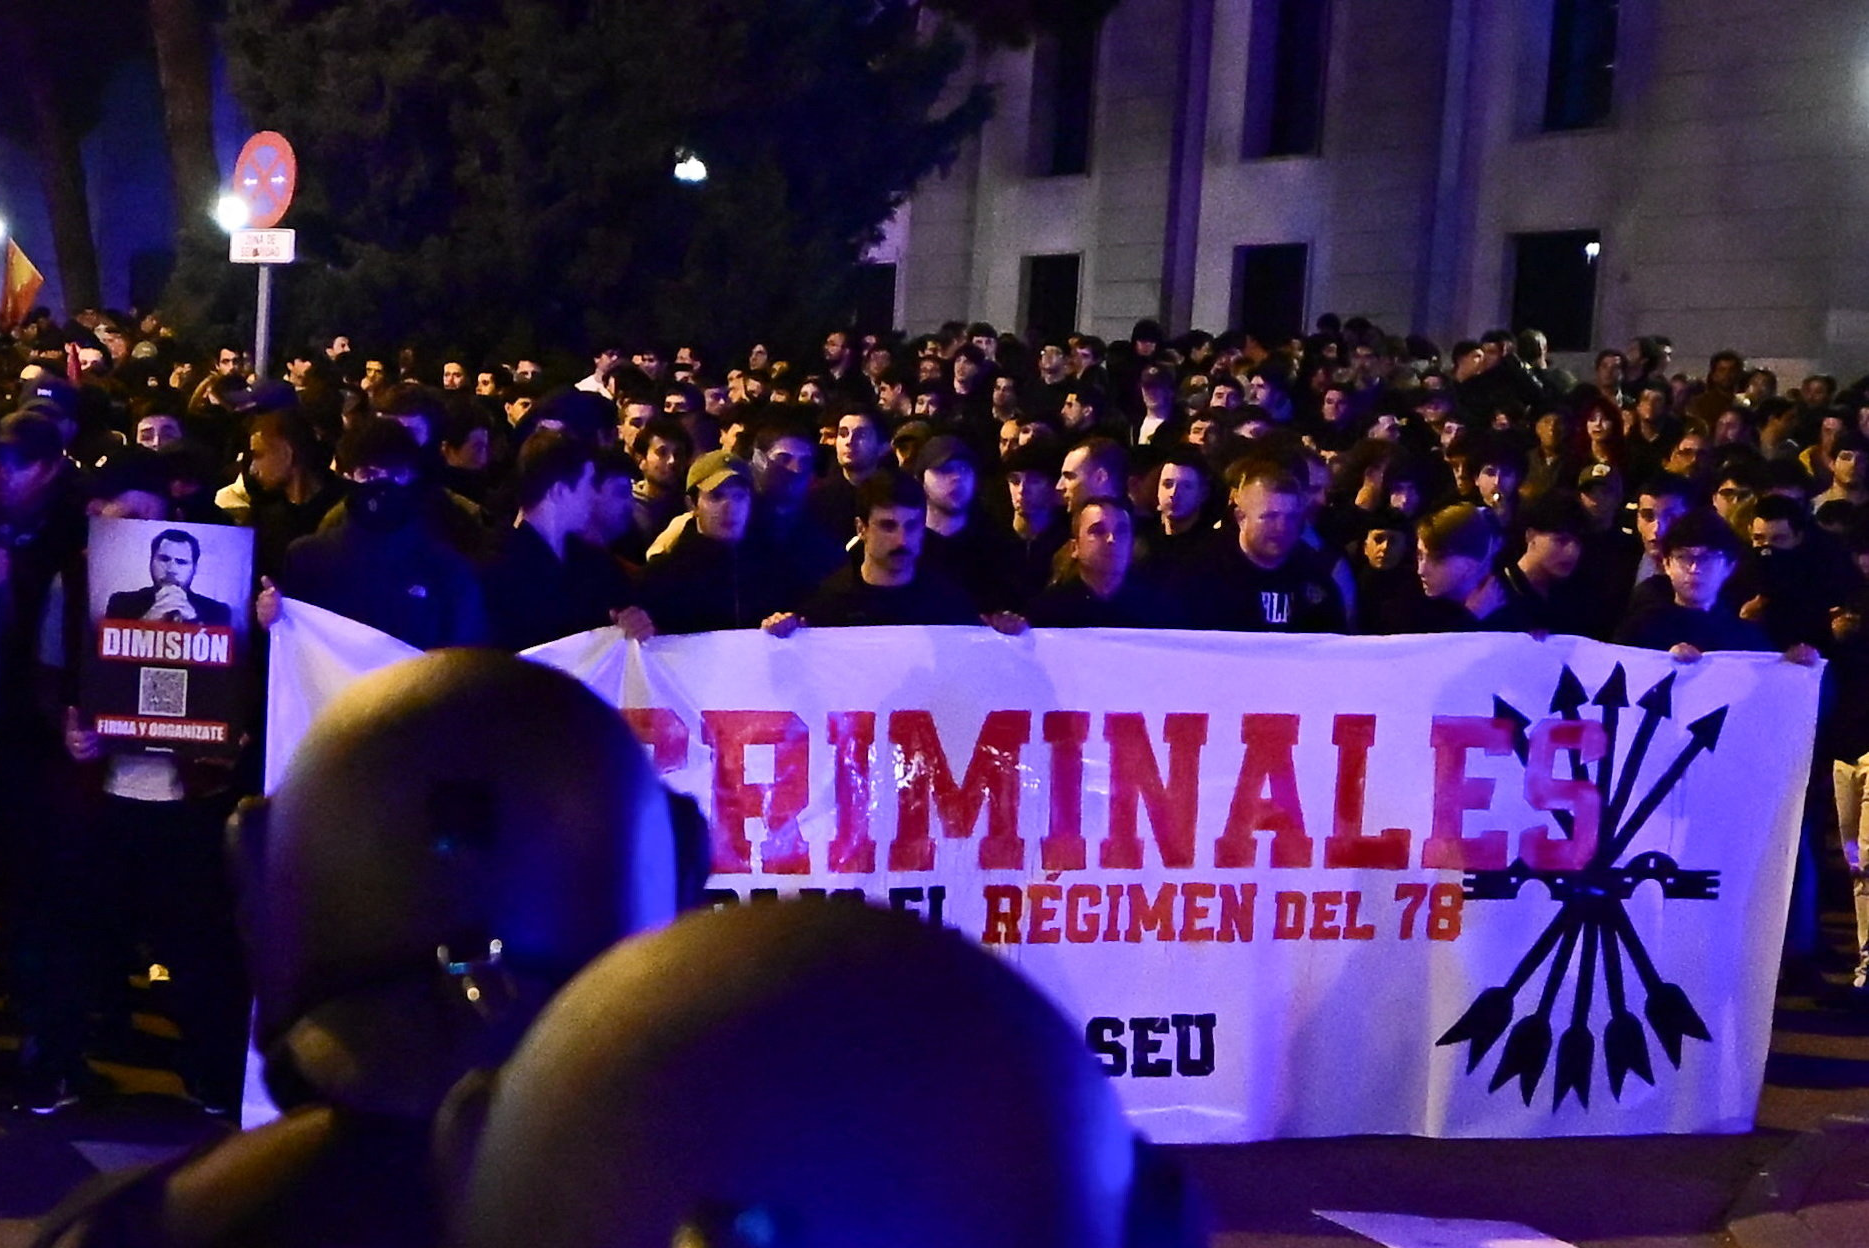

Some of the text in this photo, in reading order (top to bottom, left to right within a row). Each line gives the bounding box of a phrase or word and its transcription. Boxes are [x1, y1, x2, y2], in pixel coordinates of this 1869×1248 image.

[102, 626, 229, 664] DIMISIÓN
[97, 719, 136, 736] FIRMA
[138, 721, 148, 737] Y
[981, 871, 1258, 945] RÉGIMEN
[1273, 889, 1376, 942] DEL
[1394, 883, 1464, 942] 78
[1084, 1013, 1217, 1078] SEU
